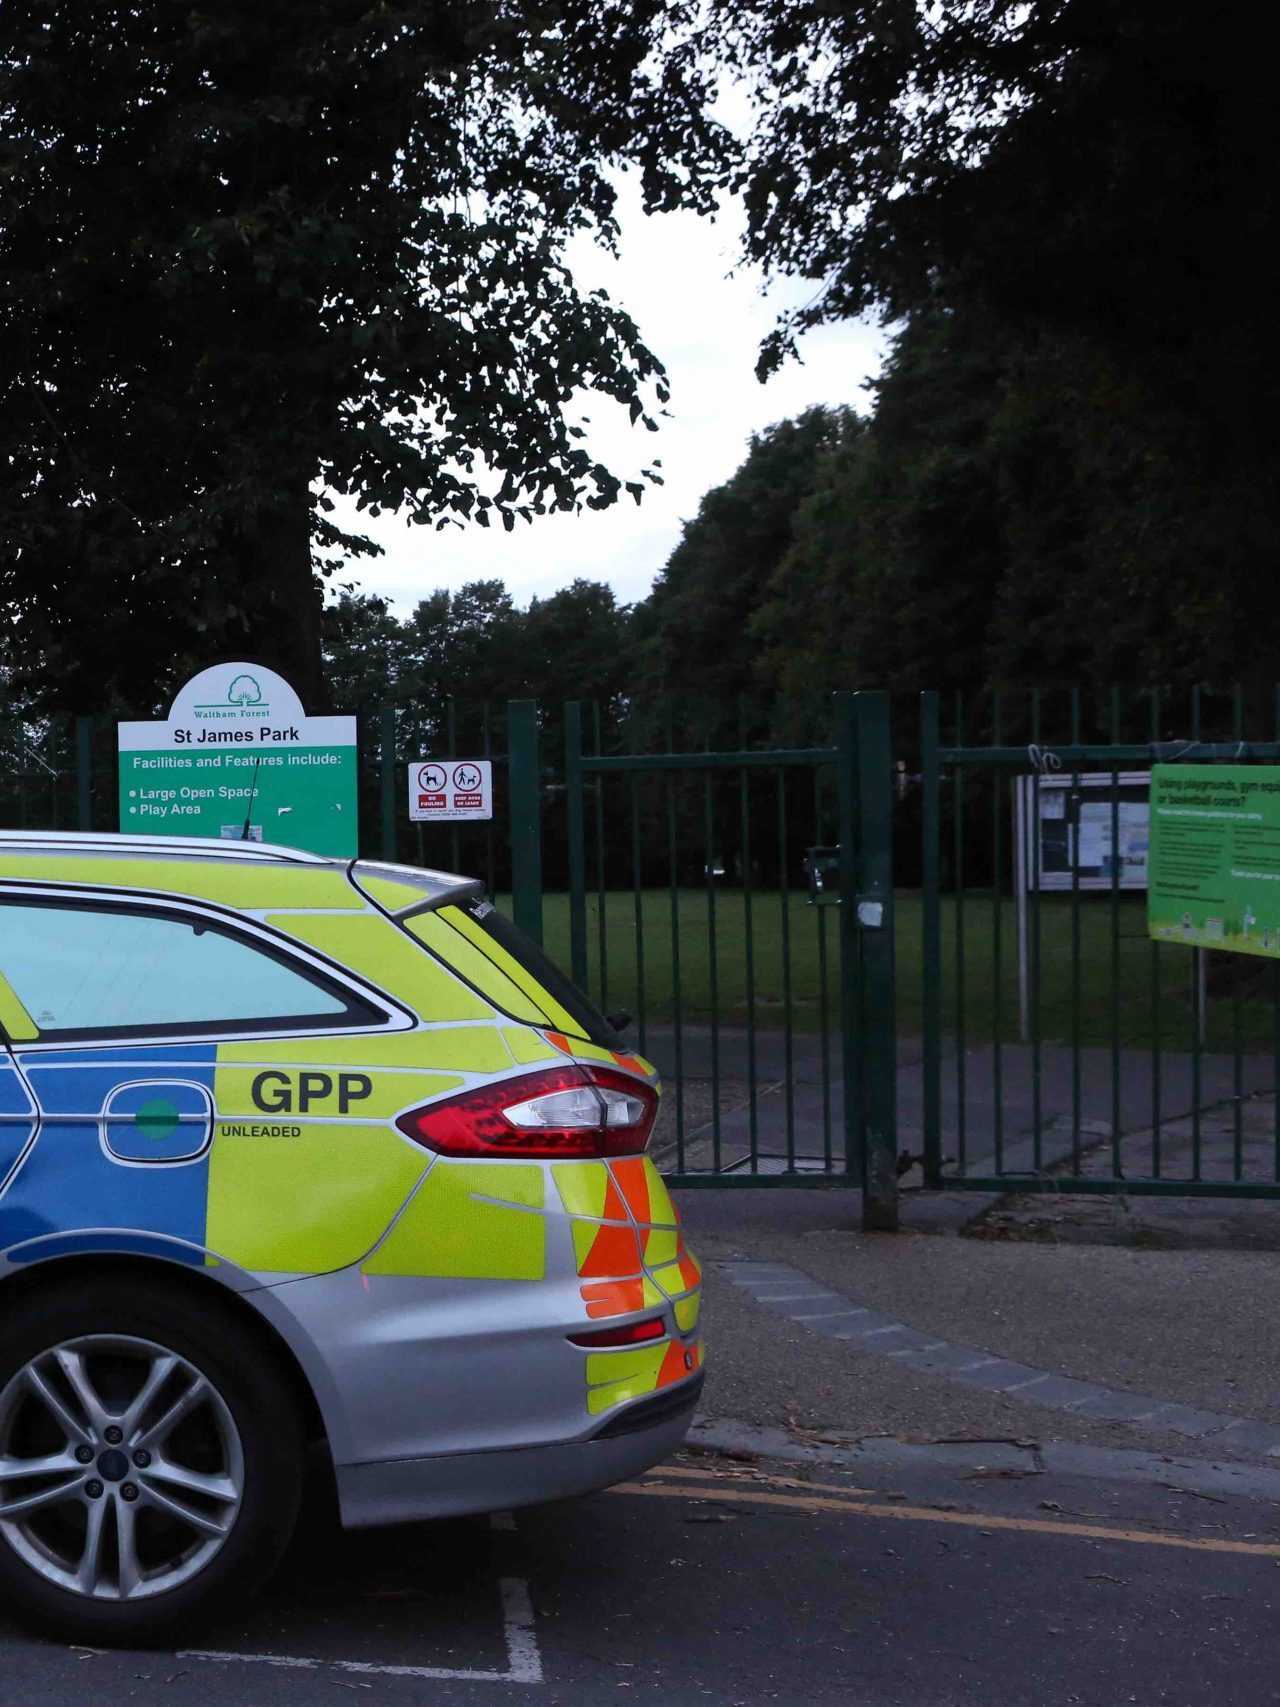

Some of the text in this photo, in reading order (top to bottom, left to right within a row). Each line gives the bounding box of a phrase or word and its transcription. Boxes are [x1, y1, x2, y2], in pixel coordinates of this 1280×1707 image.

[174, 726, 300, 744] St James Park
[133, 753, 342, 769] Facilities and Features include:
[140, 786, 259, 801] Large Open Space
[140, 803, 201, 817] Play Area
[251, 1070, 373, 1114] GPP
[221, 1126, 301, 1138] UNLEADED
